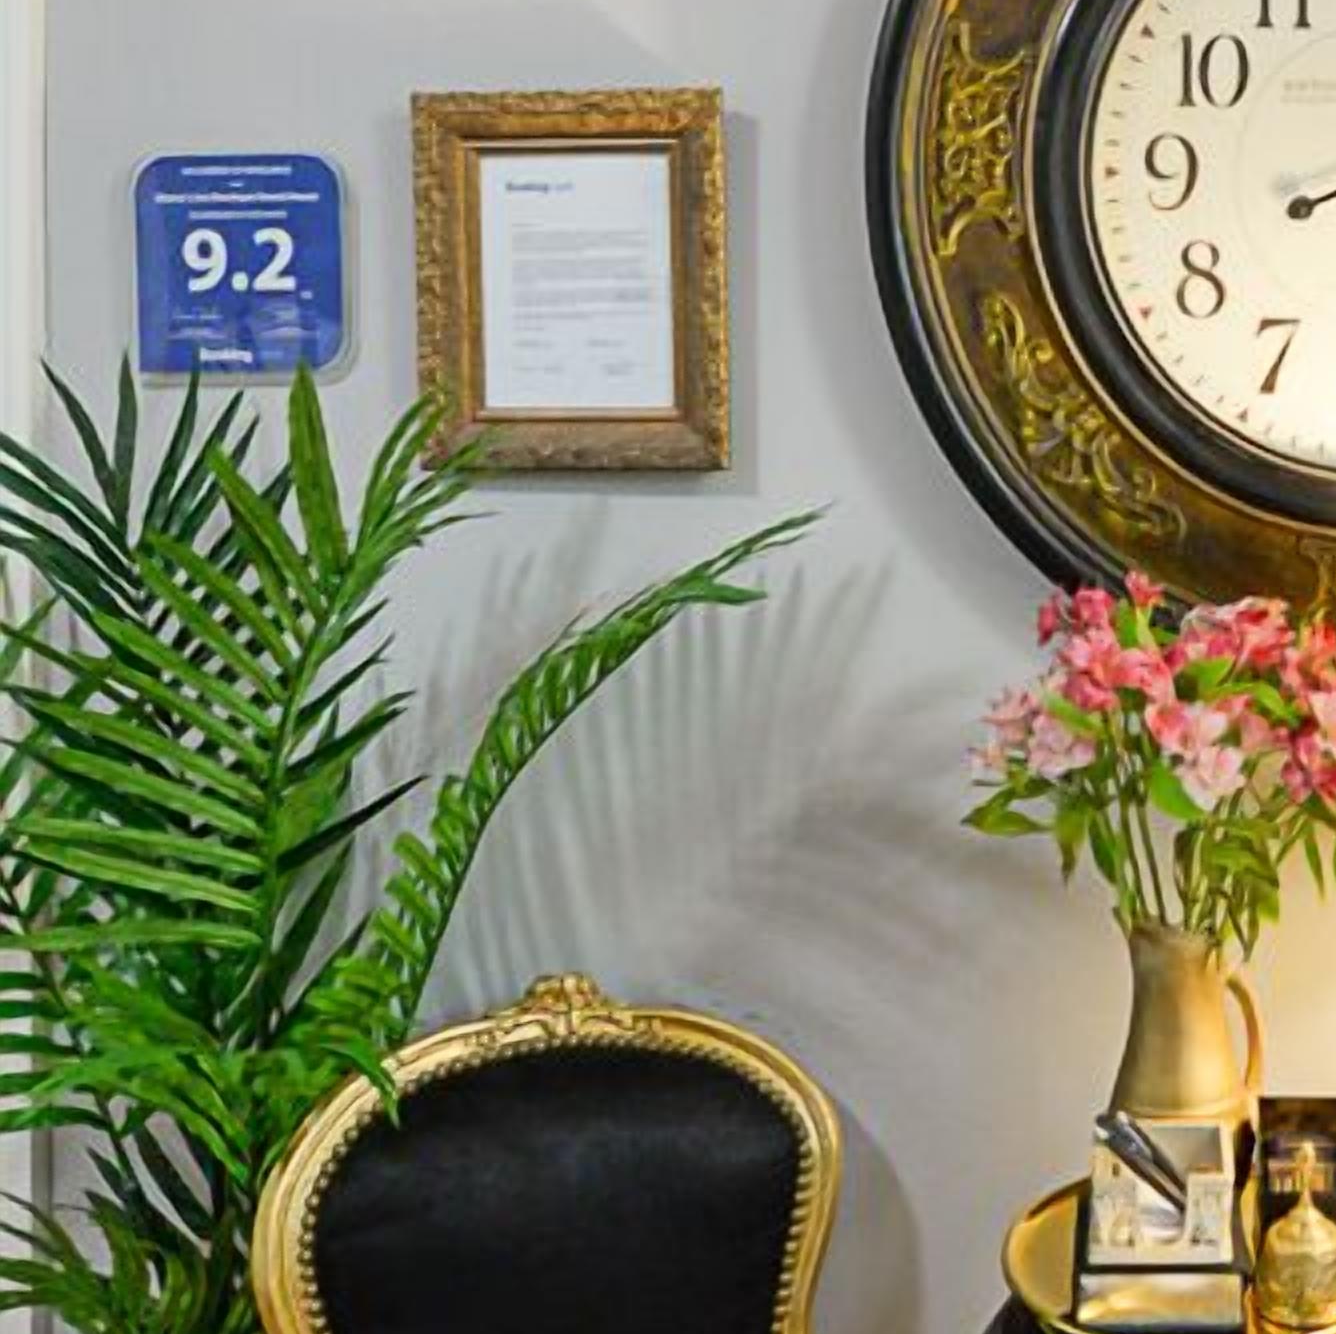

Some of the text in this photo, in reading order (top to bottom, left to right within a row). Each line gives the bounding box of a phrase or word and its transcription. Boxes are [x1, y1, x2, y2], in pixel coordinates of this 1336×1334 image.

[1178, 32, 1251, 108] 10
[1144, 133, 1199, 211] 9
[183, 227, 296, 293] 9.2
[1175, 240, 1226, 319] 8
[1254, 317, 1301, 395] 7
